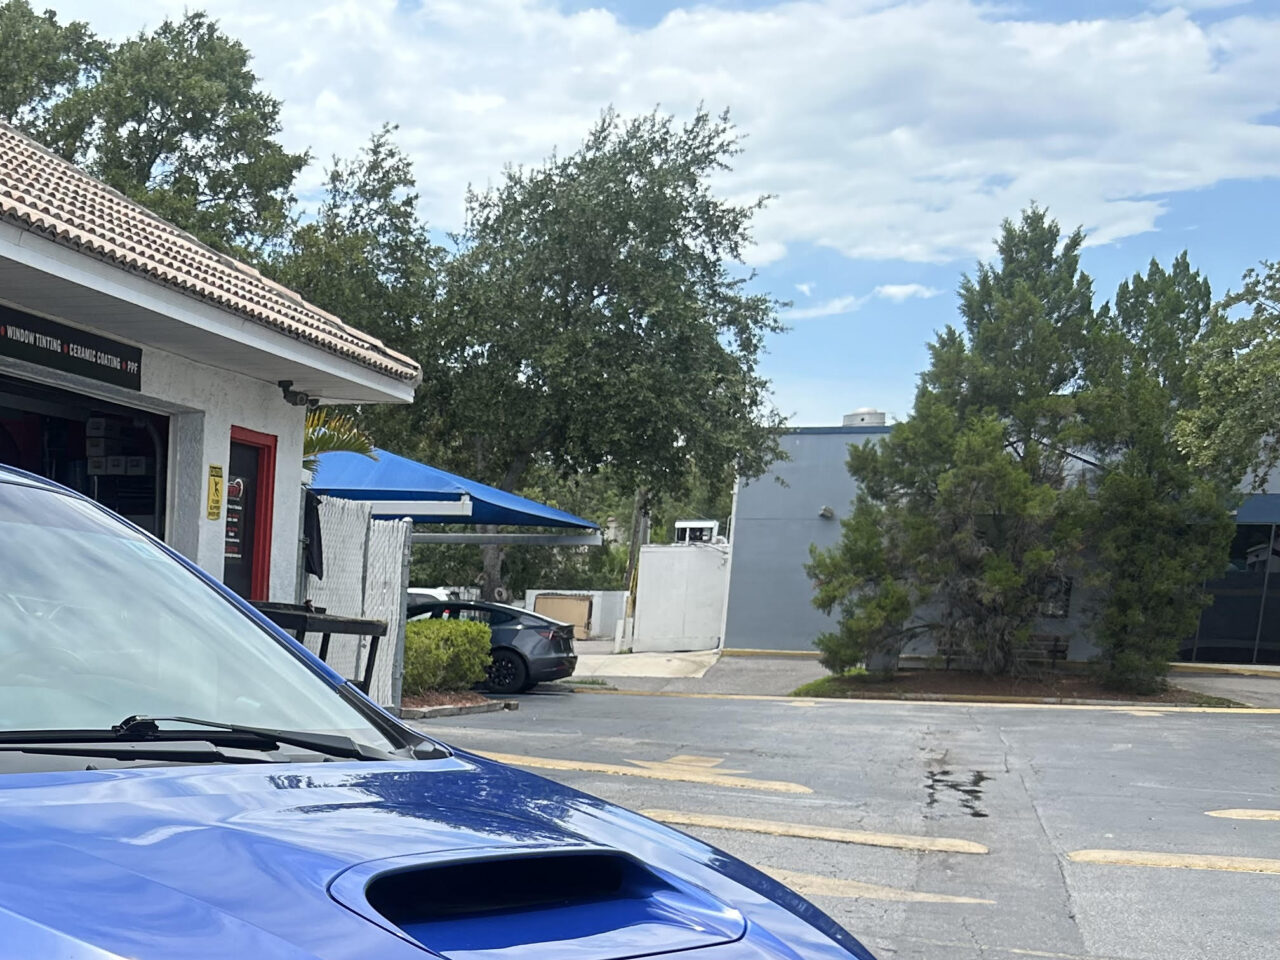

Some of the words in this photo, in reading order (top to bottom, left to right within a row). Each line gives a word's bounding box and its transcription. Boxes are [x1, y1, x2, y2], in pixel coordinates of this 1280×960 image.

[6, 325, 35, 346] WINDOW
[35, 333, 62, 353] TINTING
[69, 343, 96, 362] CERAMIC
[97, 353, 121, 370] COATING
[127, 360, 138, 374] PPF
